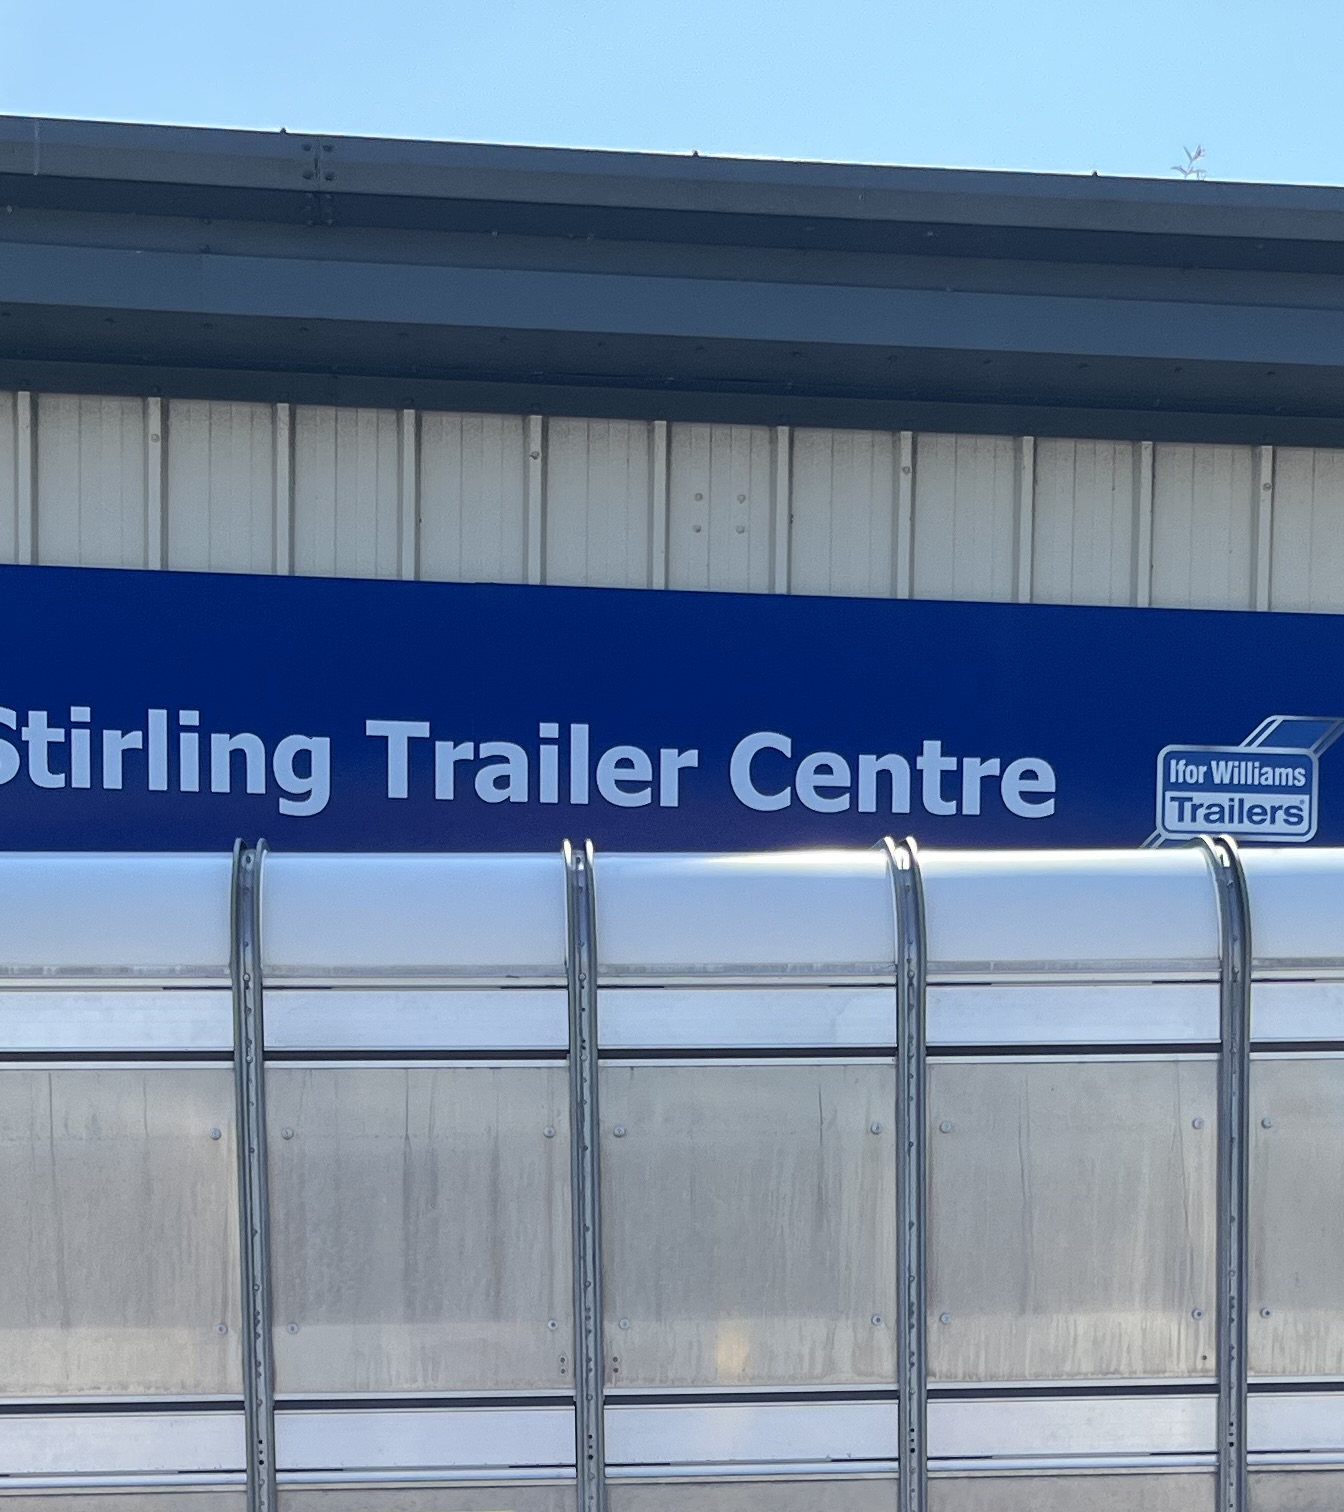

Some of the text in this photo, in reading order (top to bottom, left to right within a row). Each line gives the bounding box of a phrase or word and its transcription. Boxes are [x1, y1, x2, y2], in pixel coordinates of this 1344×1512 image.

[364, 718, 700, 808] Trailer
[729, 730, 1056, 819] Centre
[1169, 758, 1307, 788] Ifor Williams
[1169, 796, 1305, 827] Trailers
